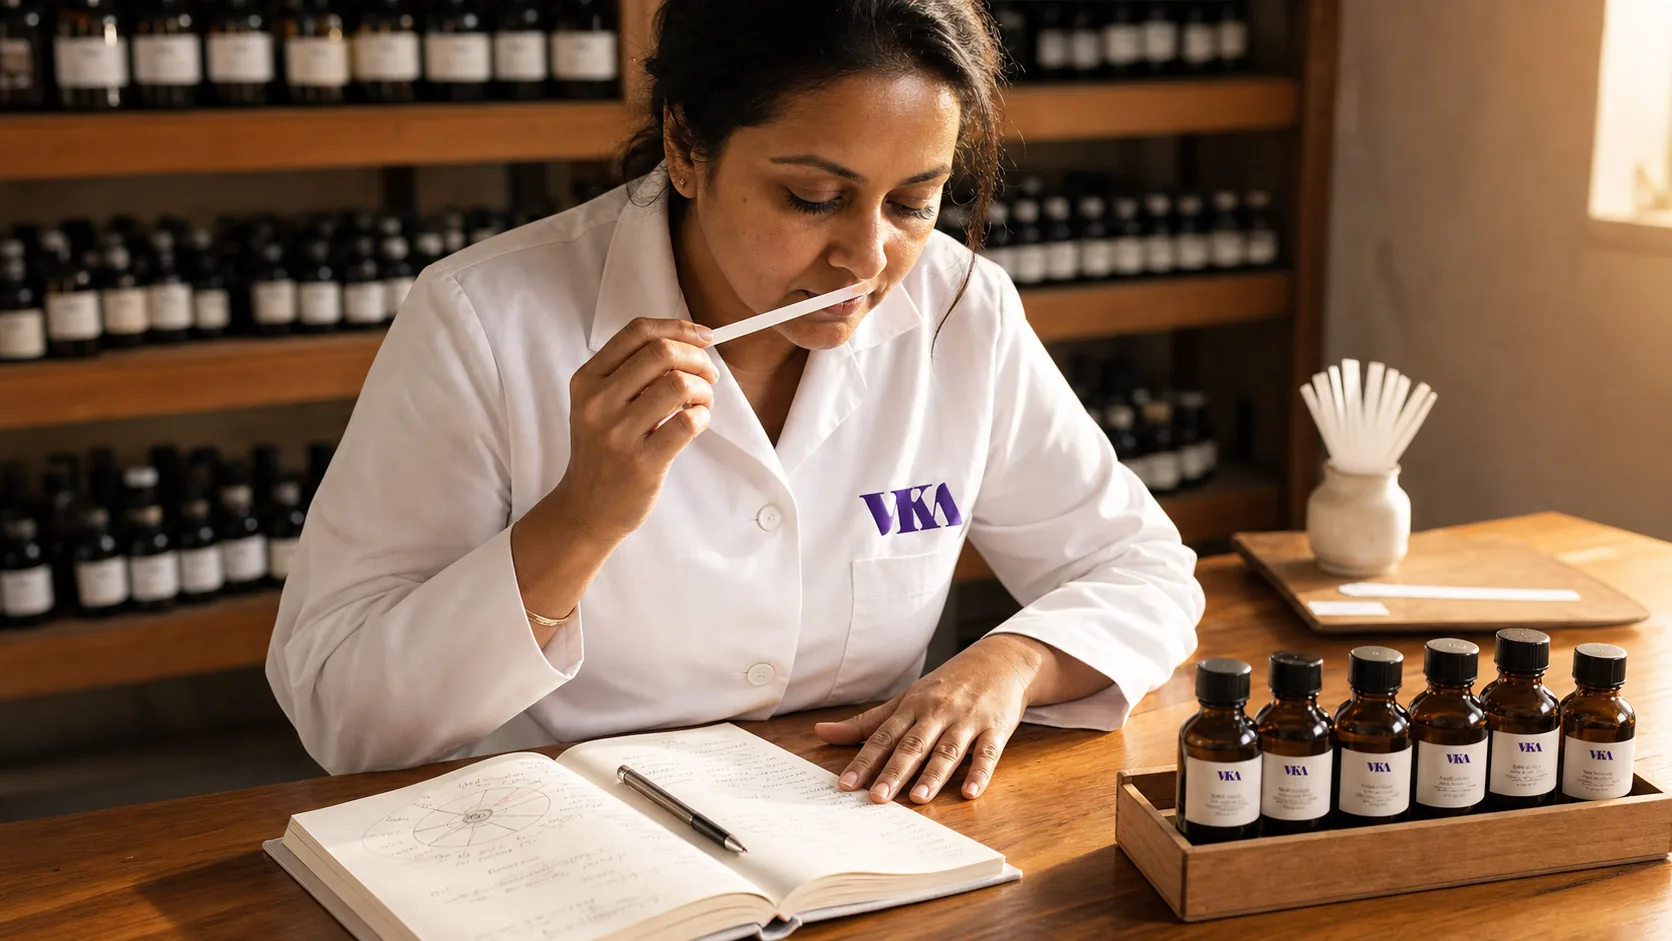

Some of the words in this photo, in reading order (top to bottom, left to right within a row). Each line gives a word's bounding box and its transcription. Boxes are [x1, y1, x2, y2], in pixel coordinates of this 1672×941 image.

[859, 482, 963, 536] VKA
[1518, 742, 1543, 752] VKA
[1446, 754, 1471, 764] VKA
[1589, 749, 1613, 760] VKA
[1284, 766, 1308, 776] VKA
[1367, 762, 1391, 772] VKA
[1217, 771, 1241, 781] VKA
